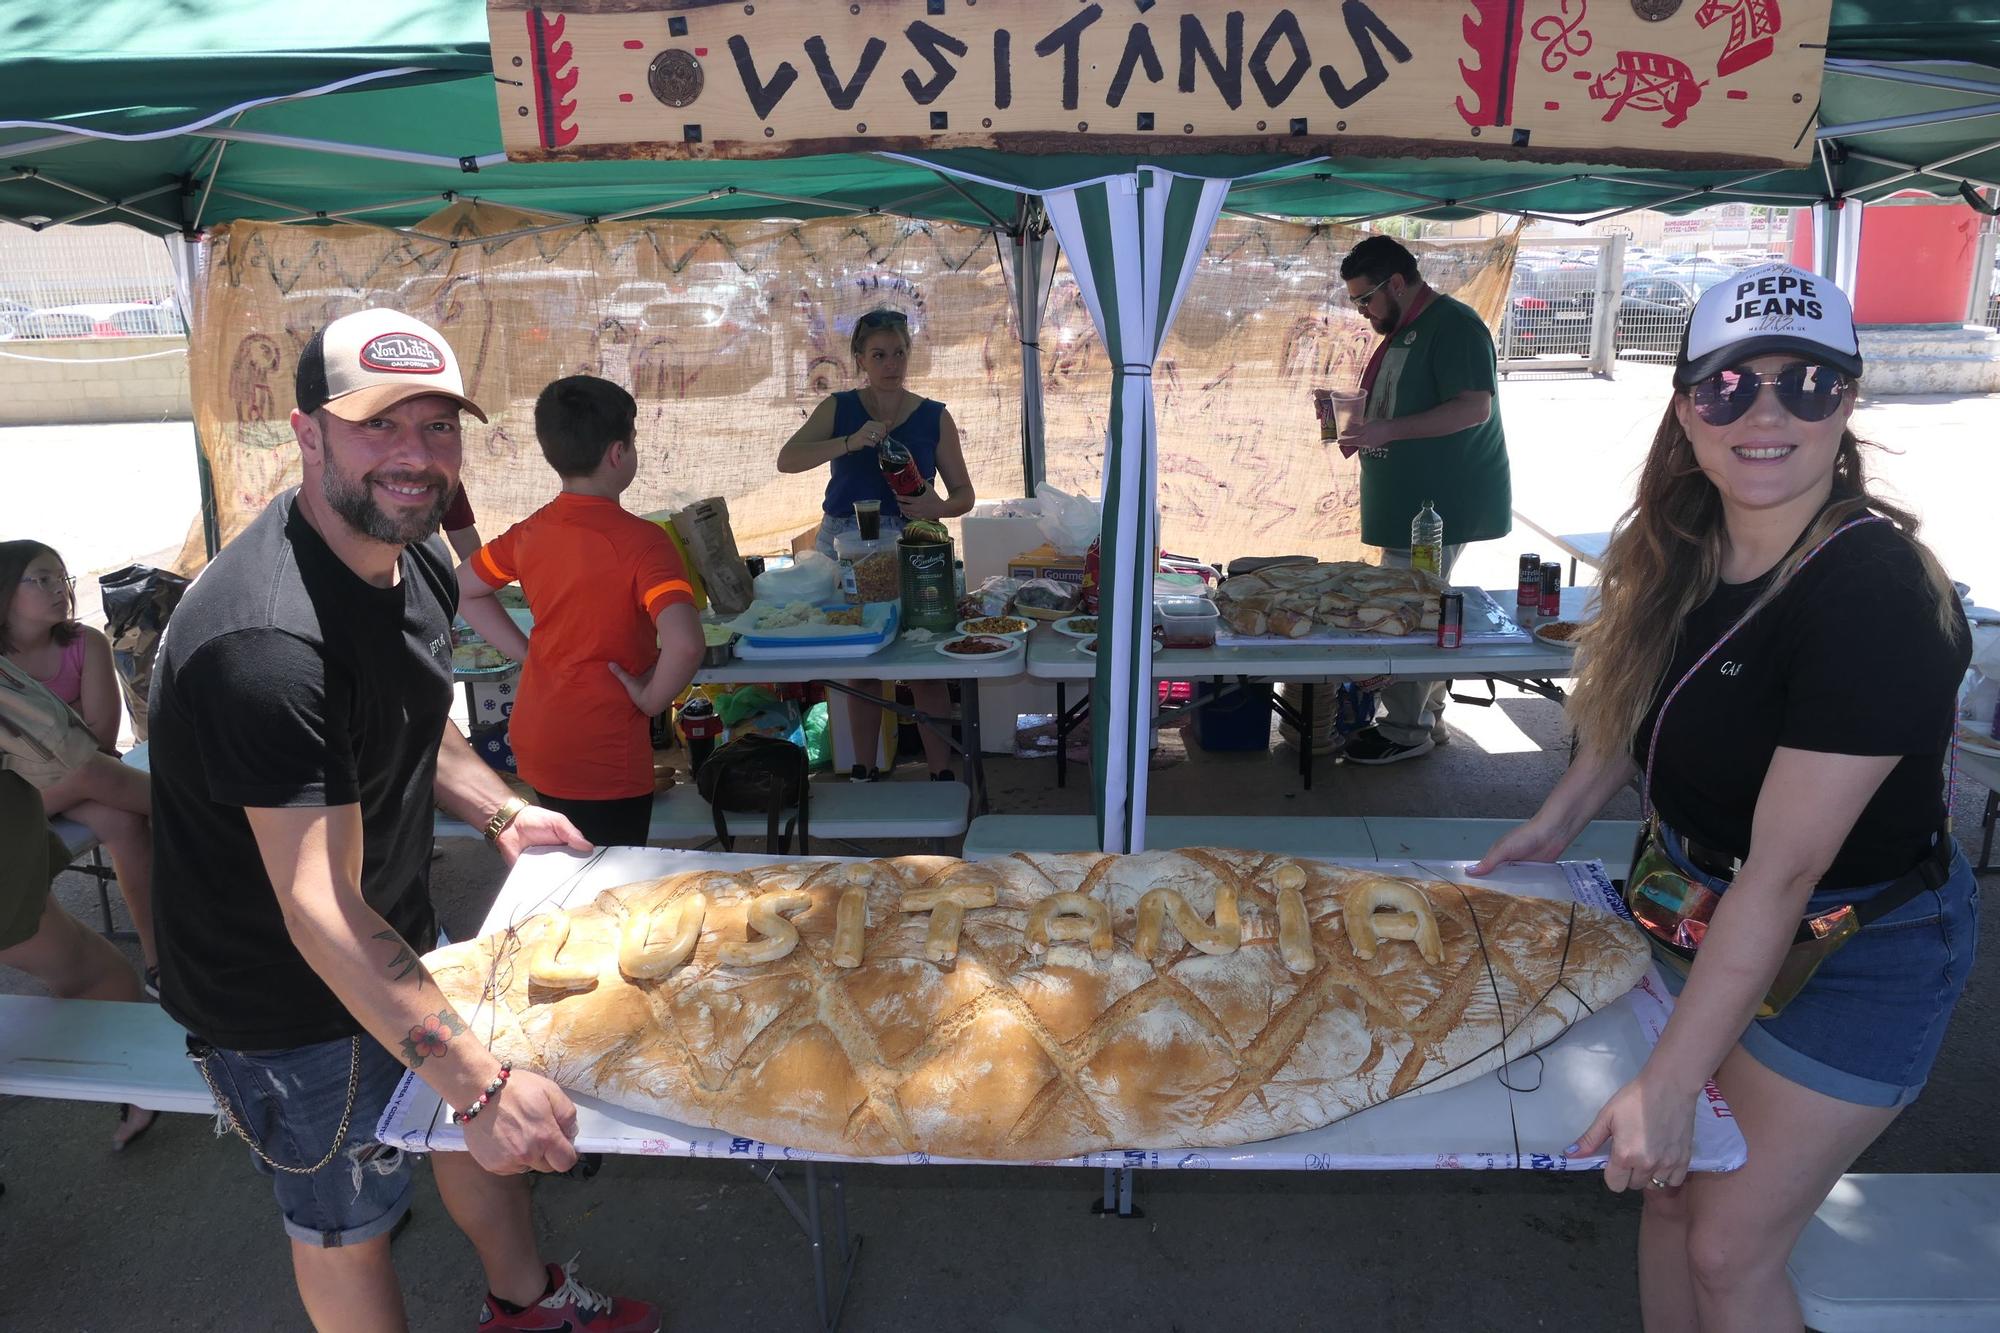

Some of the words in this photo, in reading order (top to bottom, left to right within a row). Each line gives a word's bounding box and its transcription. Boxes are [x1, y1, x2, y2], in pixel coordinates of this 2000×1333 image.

[1736, 276, 1817, 301] PEPE
[1725, 297, 1823, 324] JEANS
[397, 338, 436, 361] Dutch
[391, 360, 429, 369] CALIFORNIA
[1044, 568, 1084, 581] Gourme
